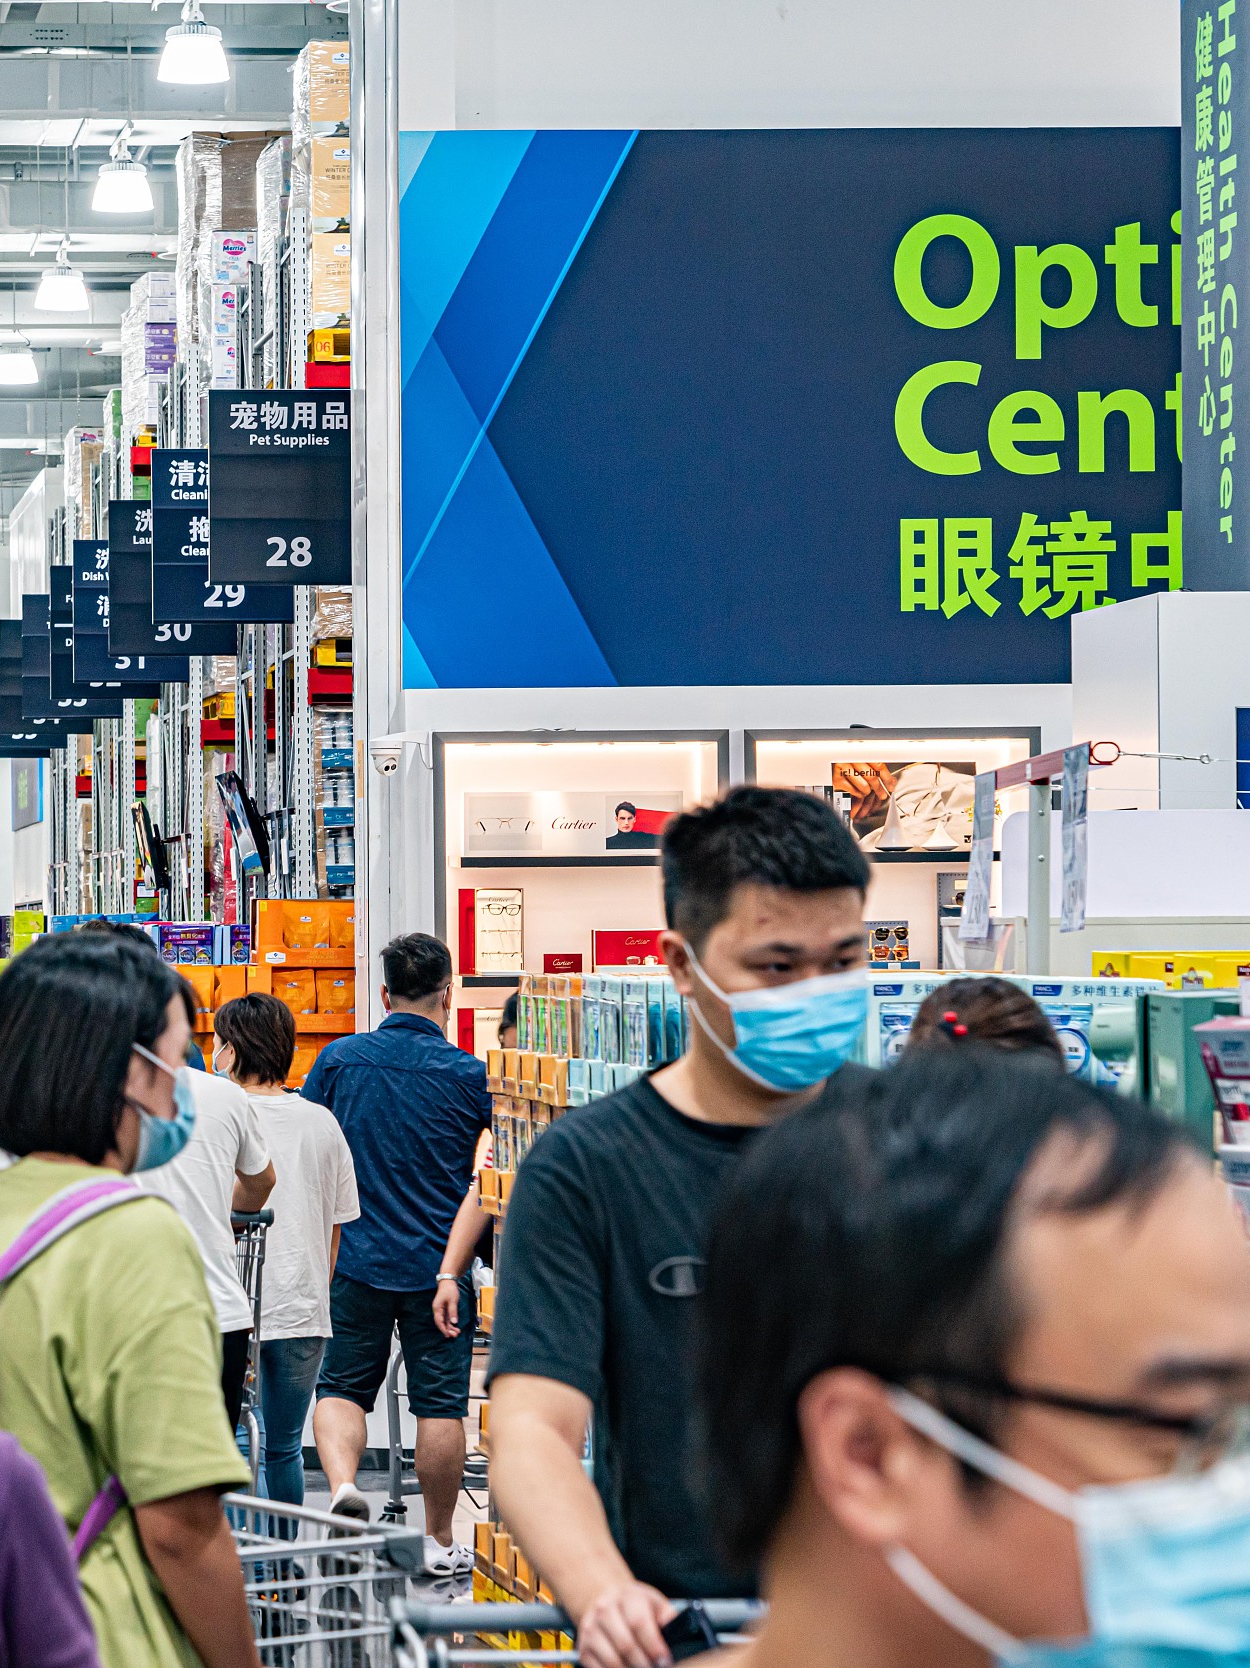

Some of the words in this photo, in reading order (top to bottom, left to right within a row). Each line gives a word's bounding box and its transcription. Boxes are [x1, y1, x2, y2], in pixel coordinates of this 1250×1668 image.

[1217, 0, 1238, 262] Health
[1194, 11, 1217, 437] 健康管理中心
[315, 341, 331, 353] 06
[229, 400, 349, 430] 宠物用品
[1219, 283, 1238, 544] Center
[249, 434, 272, 446] Pet
[273, 434, 330, 448] Supplies
[170, 489, 209, 500] Cleani
[132, 535, 152, 545] Lau
[265, 536, 313, 567] 28
[82, 571, 104, 581] Dish
[203, 580, 246, 608] 29
[154, 623, 192, 643] 30
[853, 768, 881, 777] berlin
[550, 816, 597, 831] Cartier
[624, 936, 651, 946] Cartier
[552, 958, 574, 967] Cartier
